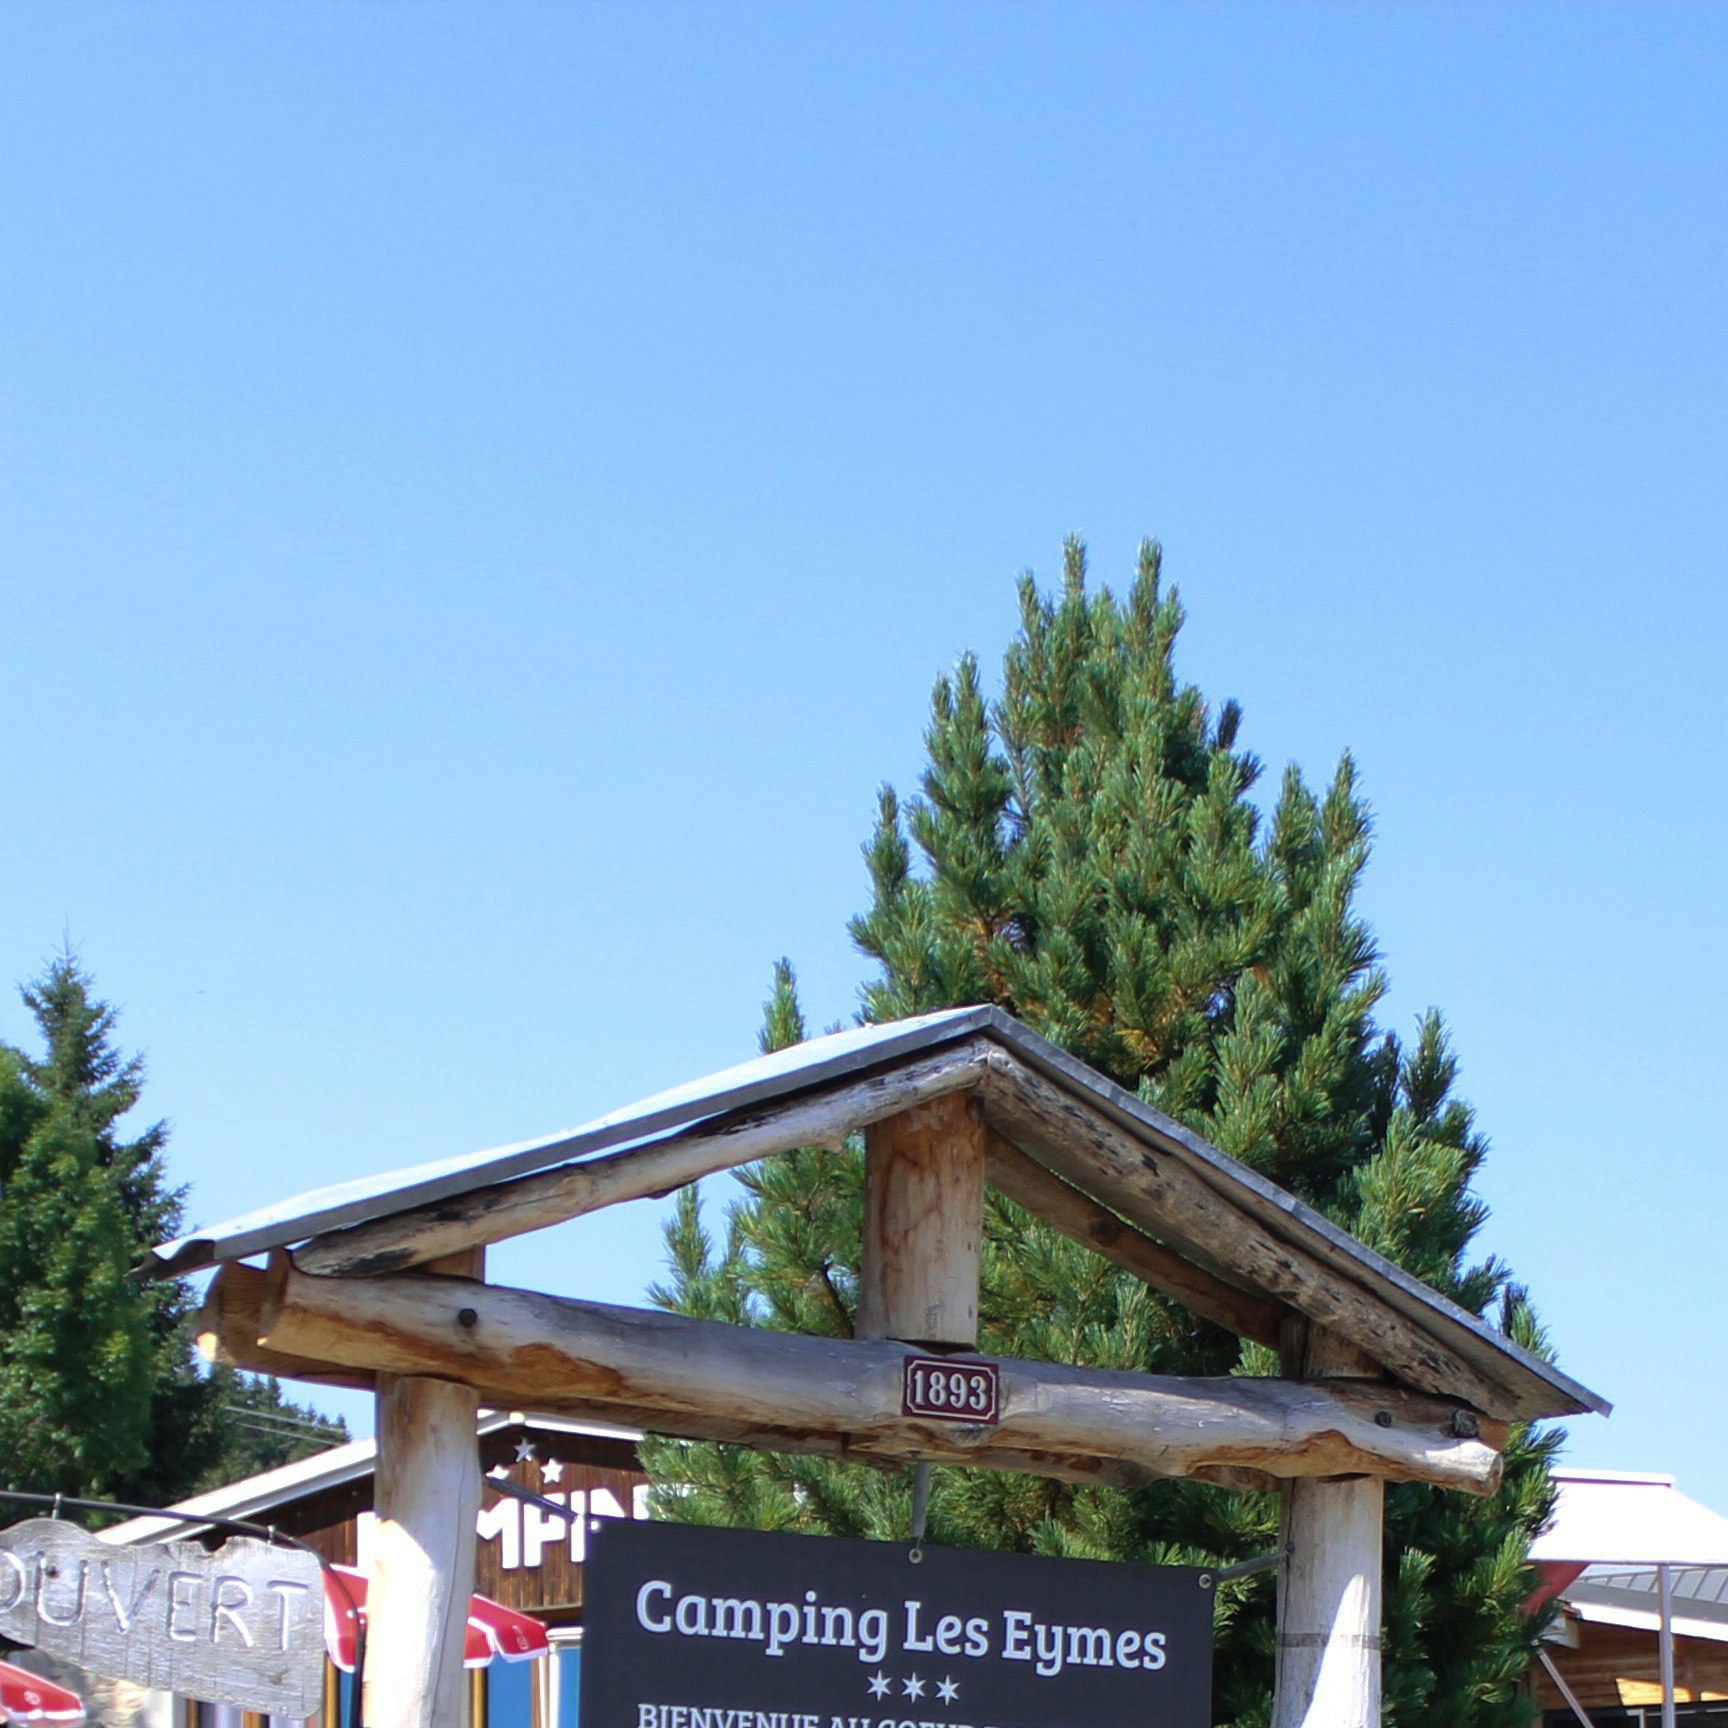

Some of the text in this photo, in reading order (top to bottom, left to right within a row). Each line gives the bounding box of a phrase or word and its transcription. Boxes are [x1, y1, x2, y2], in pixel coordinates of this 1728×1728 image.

[914, 1370, 987, 1411] 1893
[636, 1580, 1166, 1676] Camping Les Eymes
